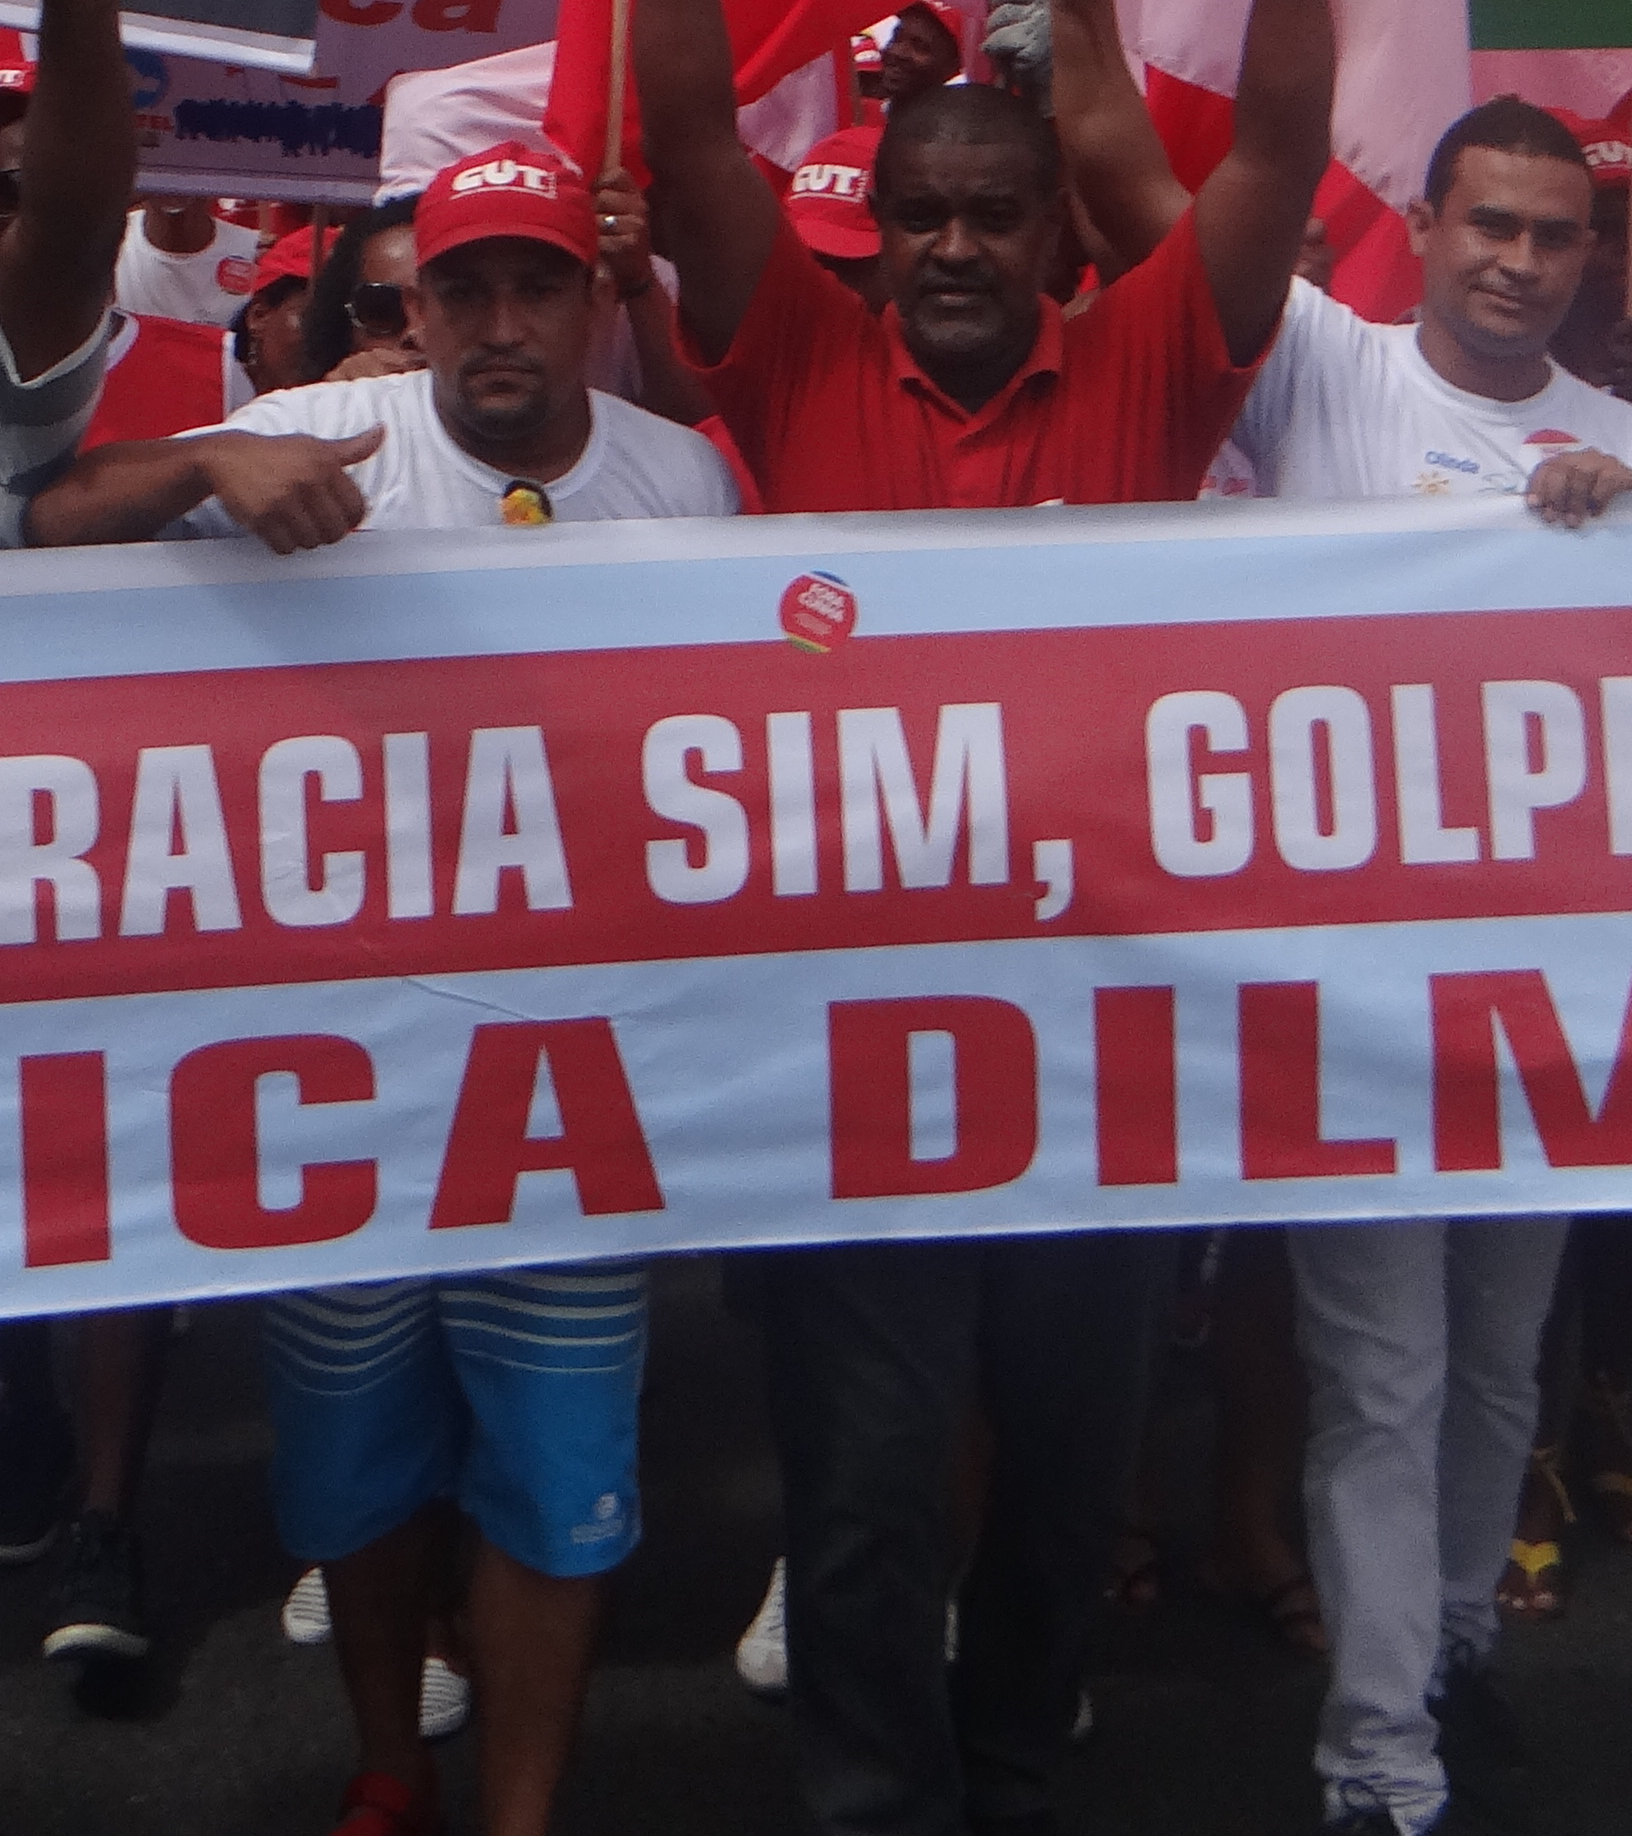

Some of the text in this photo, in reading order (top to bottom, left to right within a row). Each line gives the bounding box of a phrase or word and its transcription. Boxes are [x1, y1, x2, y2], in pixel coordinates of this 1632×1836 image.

[451, 159, 548, 192] CUT
[791, 163, 863, 195] CUT
[641, 701, 1074, 921] SIM,
